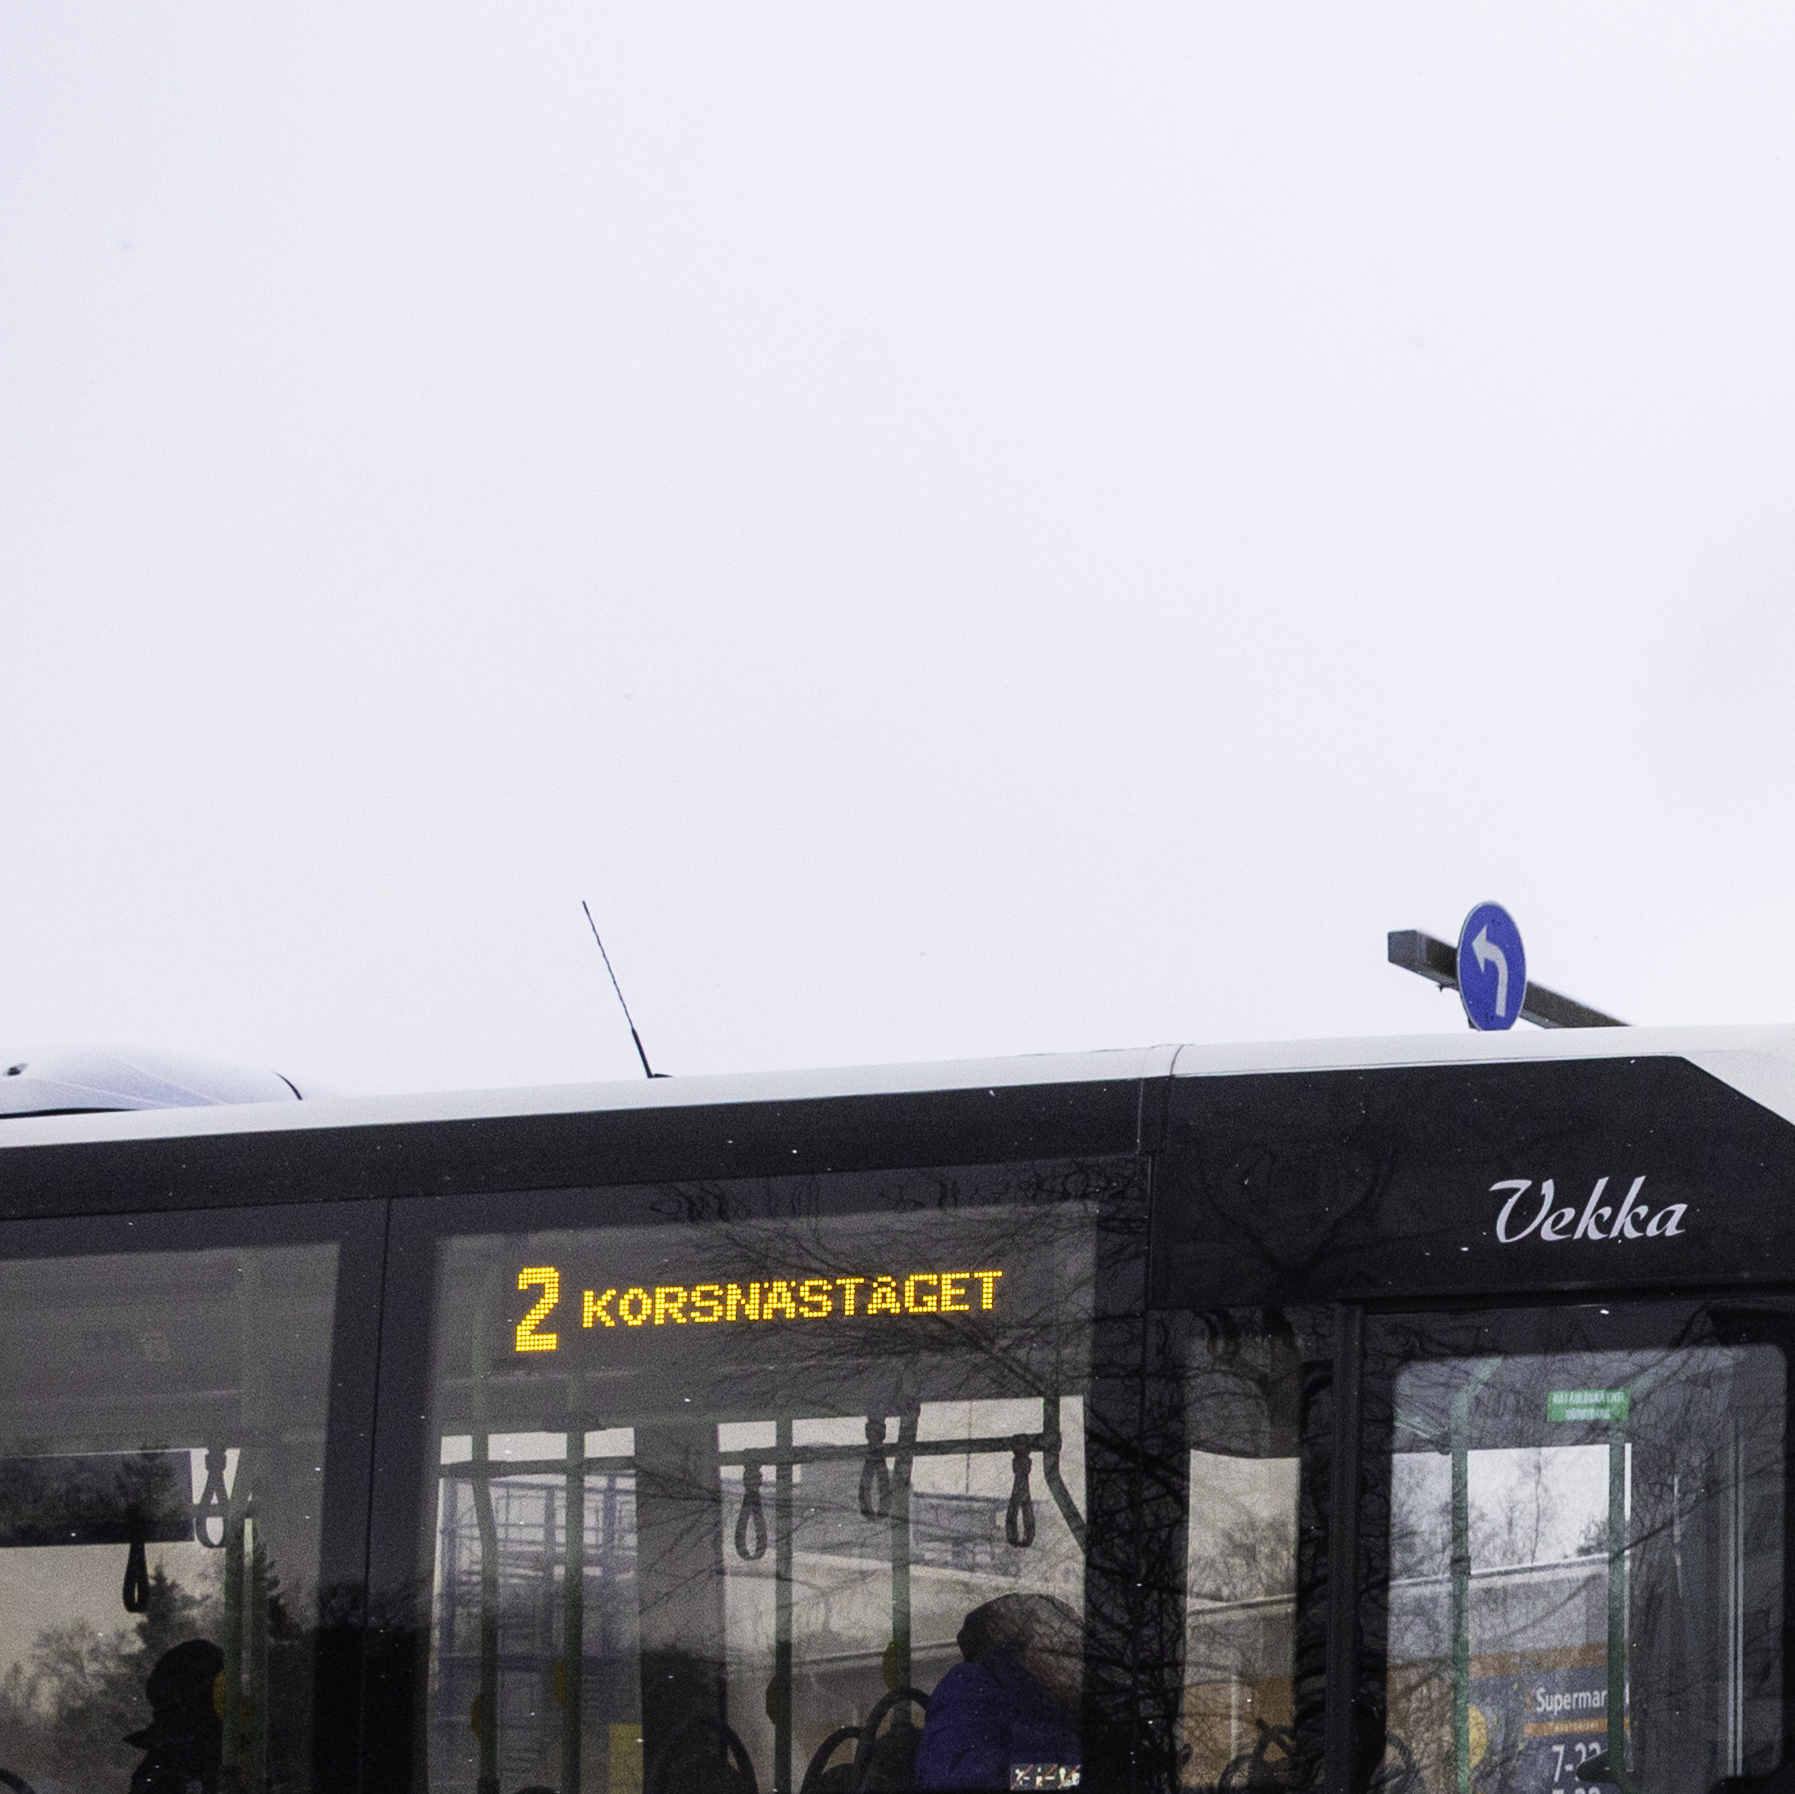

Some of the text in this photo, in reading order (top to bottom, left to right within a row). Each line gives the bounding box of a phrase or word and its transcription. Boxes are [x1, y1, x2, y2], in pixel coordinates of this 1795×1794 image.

[1489, 1175, 1688, 1243] Vekka
[515, 1266, 1003, 1352] 2 KORSNÄSTÅGET
[1536, 1686, 1609, 1716] Supermar
